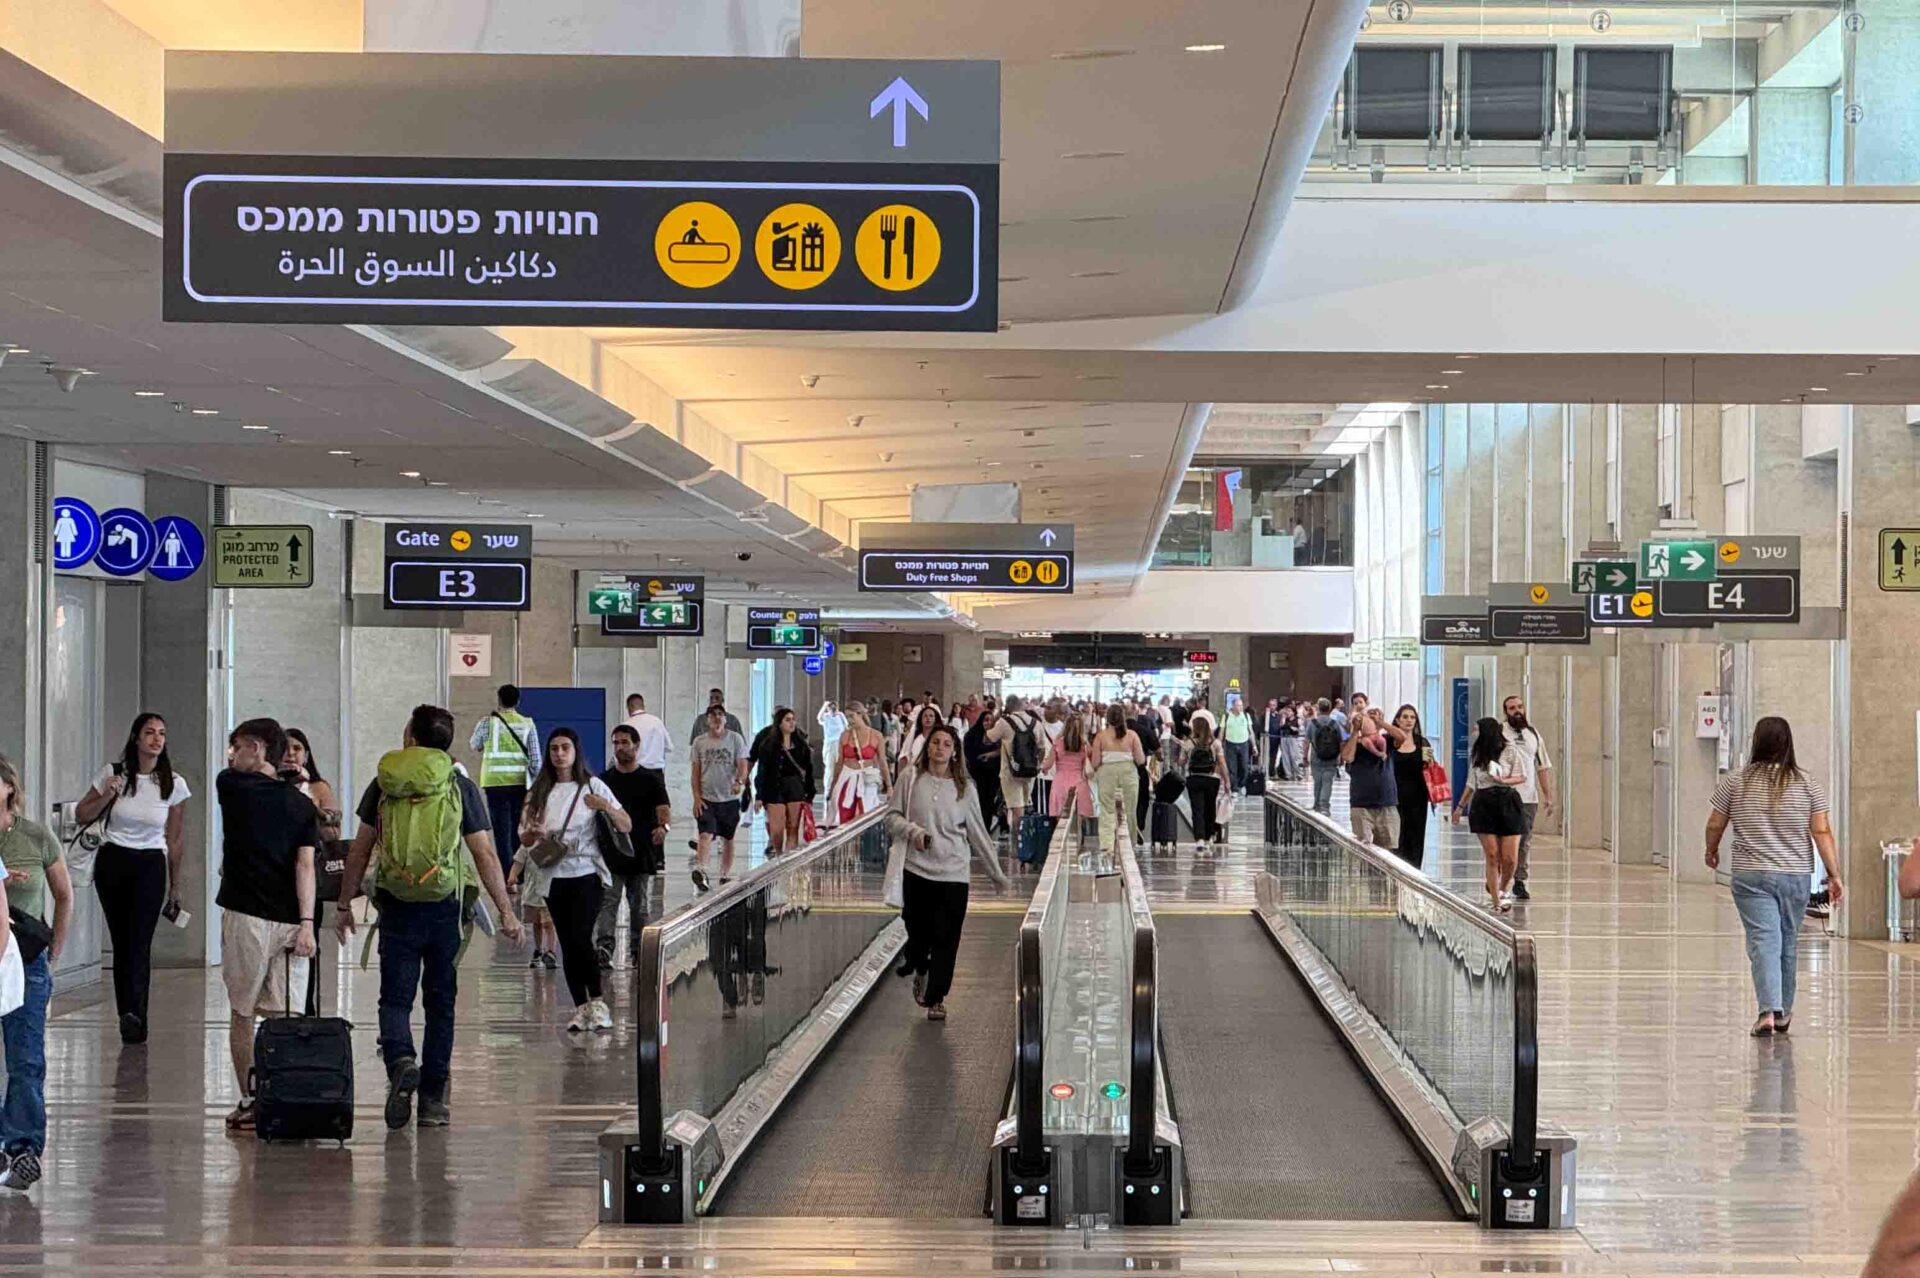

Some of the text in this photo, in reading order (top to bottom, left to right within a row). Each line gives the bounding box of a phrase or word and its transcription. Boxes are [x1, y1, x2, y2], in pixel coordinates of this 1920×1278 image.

[237, 206, 598, 236] חנויות פטורות ממכס
[278, 247, 557, 286] دكاكين السوق الحرة
[396, 529, 440, 546] Gate
[482, 535, 519, 549] שער
[222, 542, 279, 554] מרחב מוגן
[1751, 546, 1788, 559] שער
[223, 555, 279, 565] PROTECTED
[895, 561, 923, 569] ממכס
[238, 568, 264, 577] AREA
[906, 573, 978, 584] Duty Free Shops
[439, 570, 476, 597] E3
[1708, 583, 1746, 609] E4
[1600, 594, 1623, 615] E1
[750, 610, 783, 619] Counter
